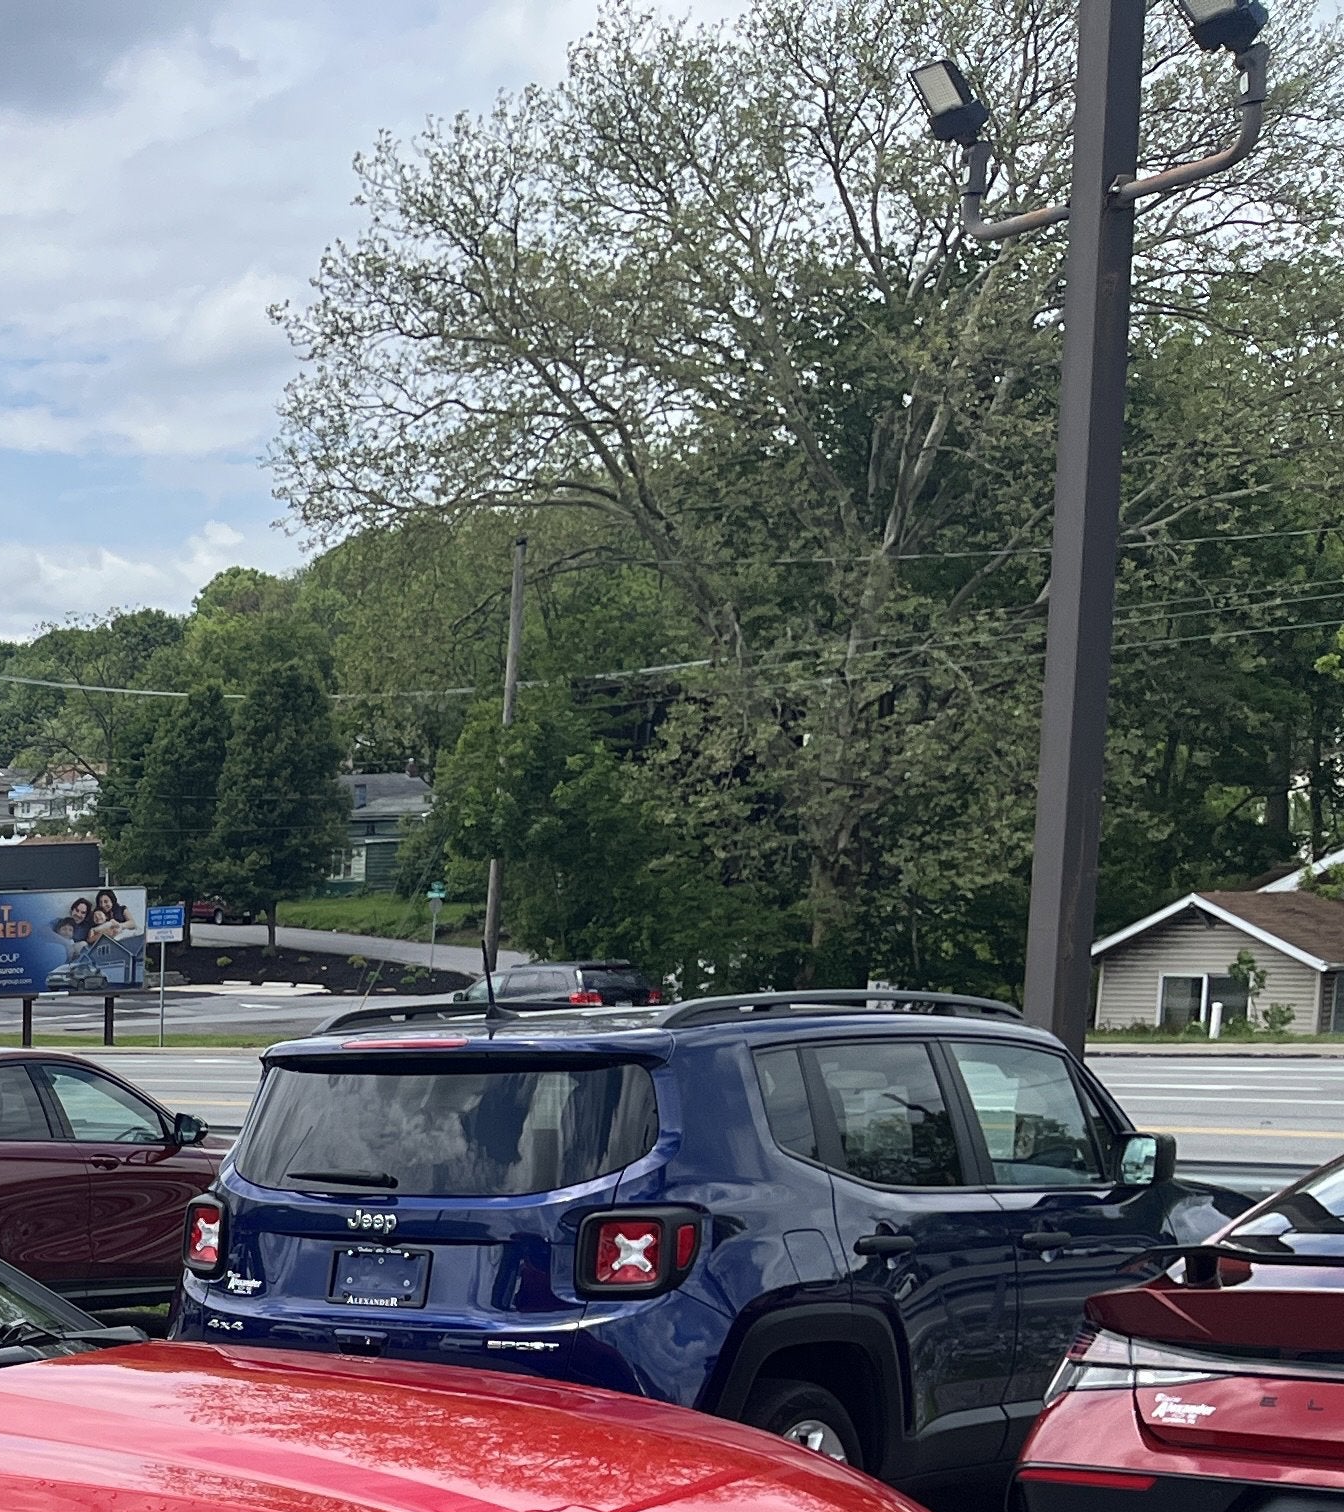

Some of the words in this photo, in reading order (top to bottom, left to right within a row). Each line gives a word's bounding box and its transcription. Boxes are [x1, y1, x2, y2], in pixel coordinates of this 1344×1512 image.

[347, 1210, 397, 1234] Jeep
[346, 1294, 398, 1308] ALEXANDER
[207, 1318, 244, 1331] 4x4
[487, 1340, 560, 1352] SPORT
